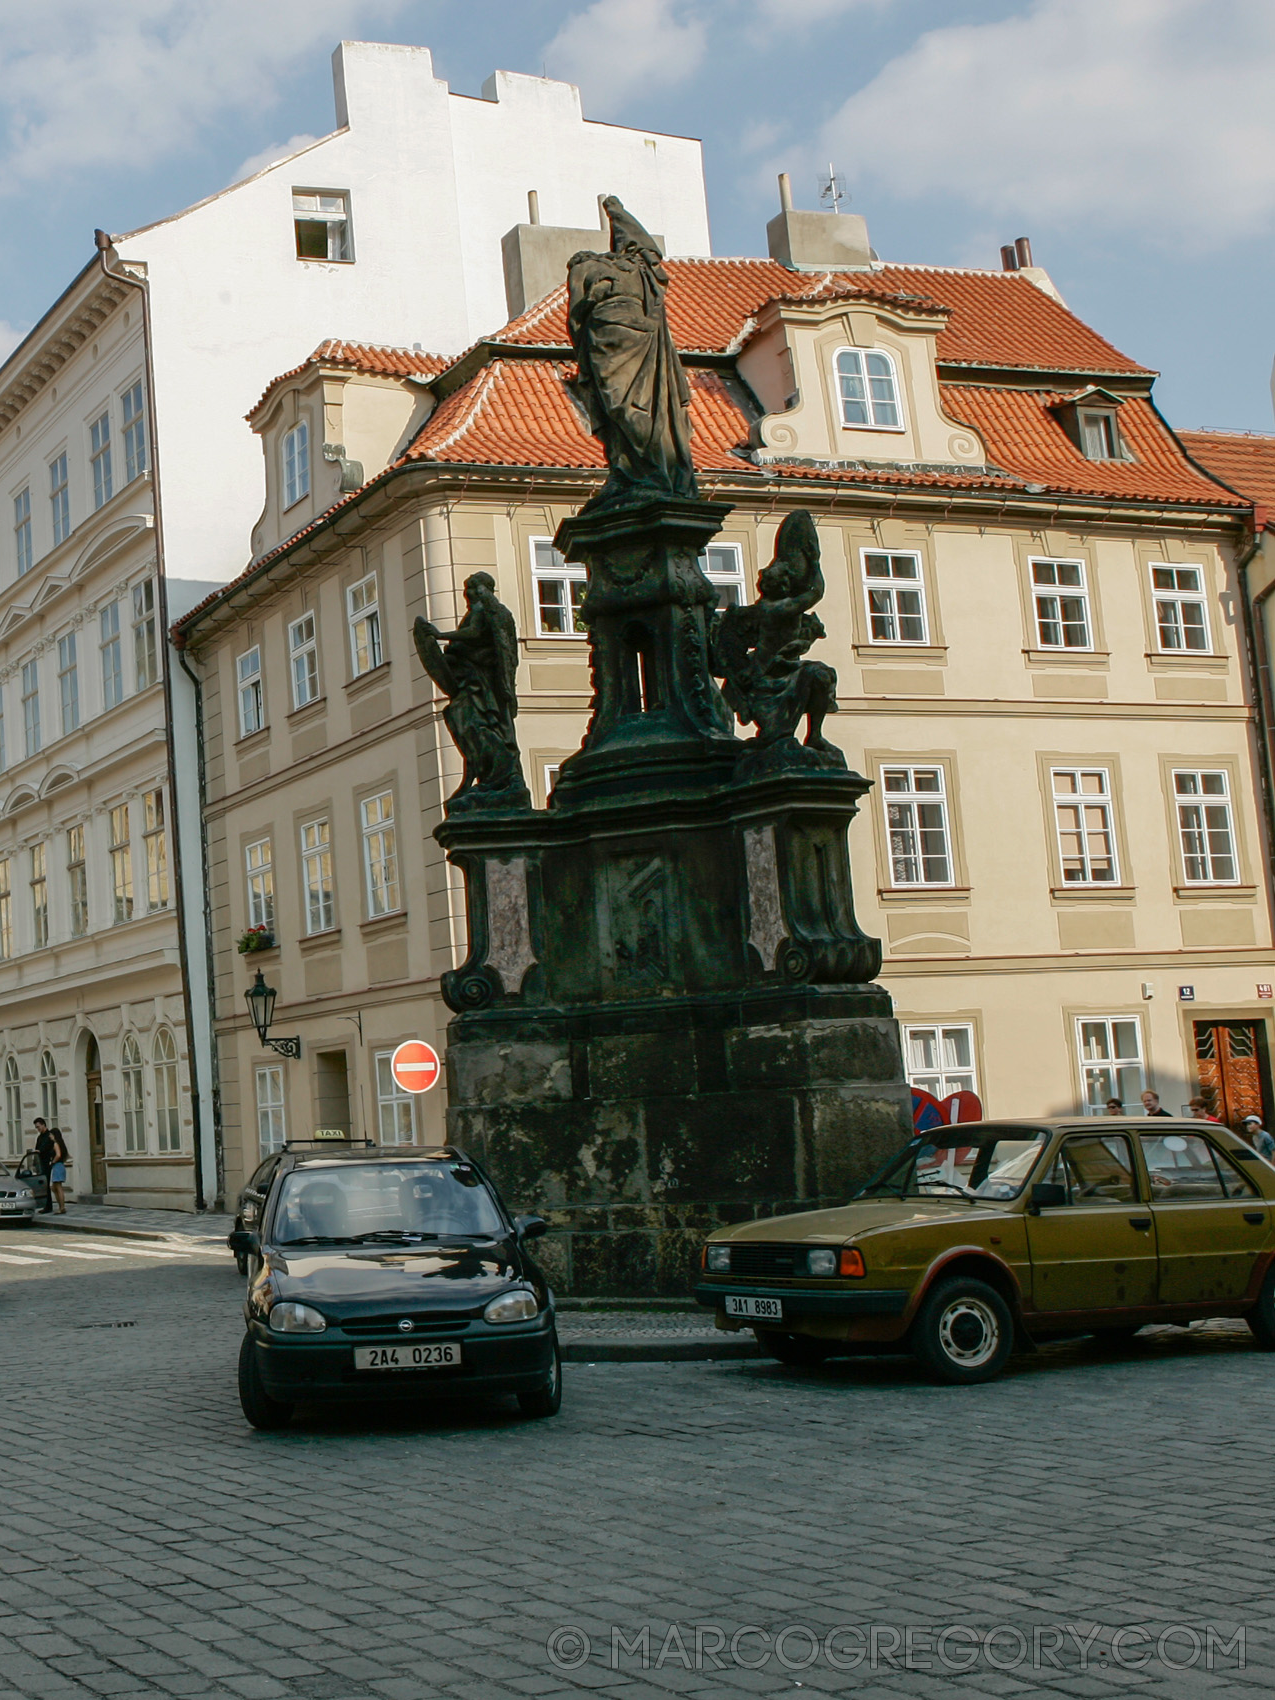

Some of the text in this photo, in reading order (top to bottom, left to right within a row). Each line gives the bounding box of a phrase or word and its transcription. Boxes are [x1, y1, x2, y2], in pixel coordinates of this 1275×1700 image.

[733, 1298, 778, 1315] 3A1 8983
[369, 1346, 453, 1366] 2A4 0236
